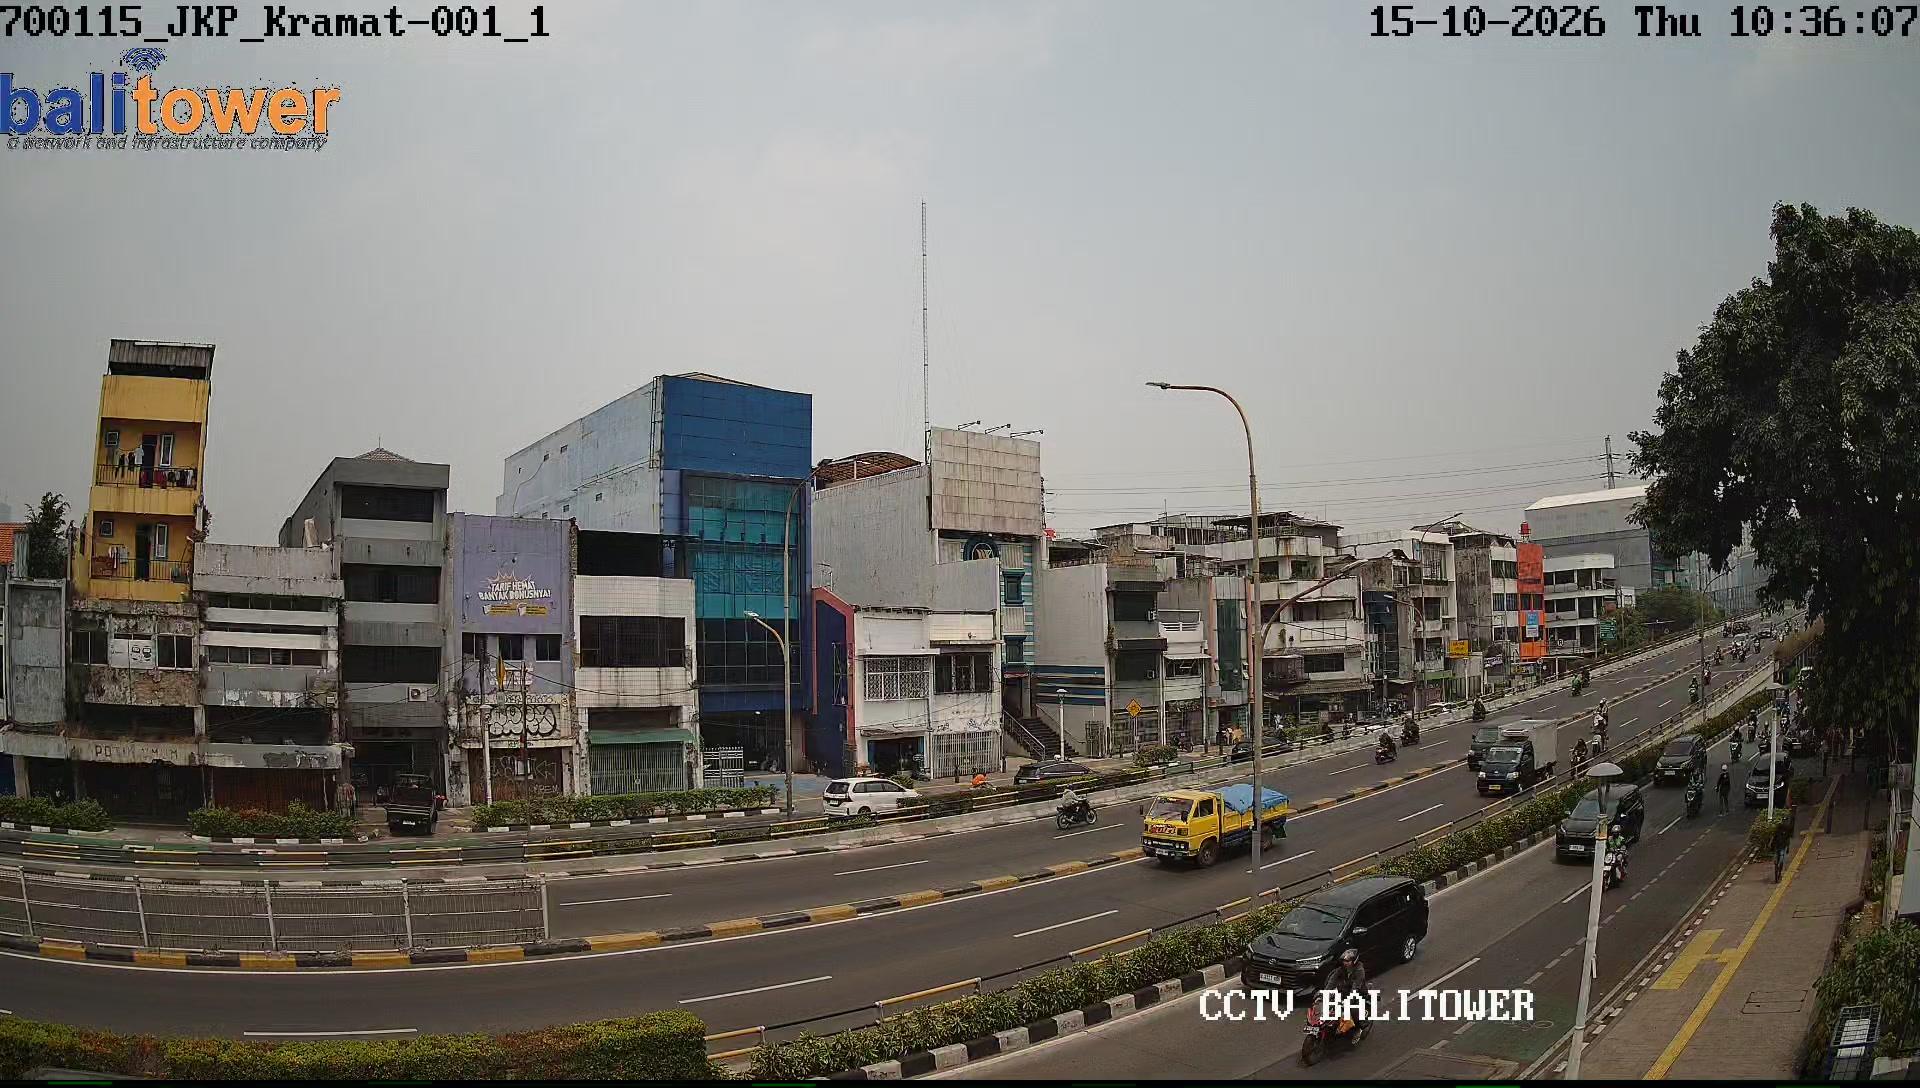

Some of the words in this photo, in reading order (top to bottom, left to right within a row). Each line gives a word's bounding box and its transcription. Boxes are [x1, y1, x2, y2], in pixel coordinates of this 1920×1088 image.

[491, 582, 512, 593] TARIF
[512, 580, 536, 591] HEMAT
[478, 590, 508, 601] BANYAK
